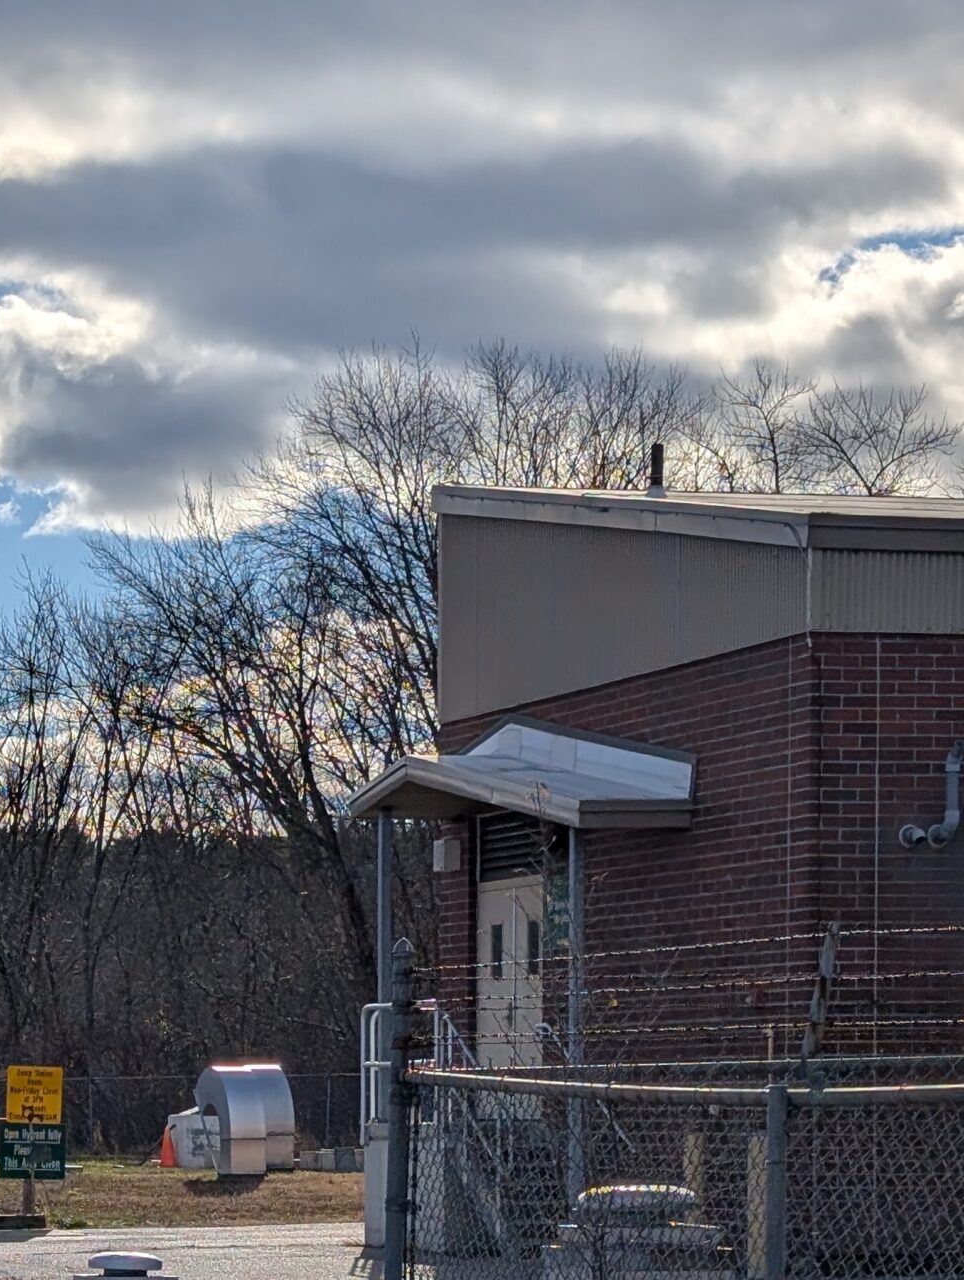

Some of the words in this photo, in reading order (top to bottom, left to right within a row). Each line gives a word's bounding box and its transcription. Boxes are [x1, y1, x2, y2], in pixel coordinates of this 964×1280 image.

[4, 1128, 19, 1141] Open
[47, 1128, 62, 1145] fully
[13, 1144, 32, 1156] Pleas
[4, 1156, 18, 1168] This
